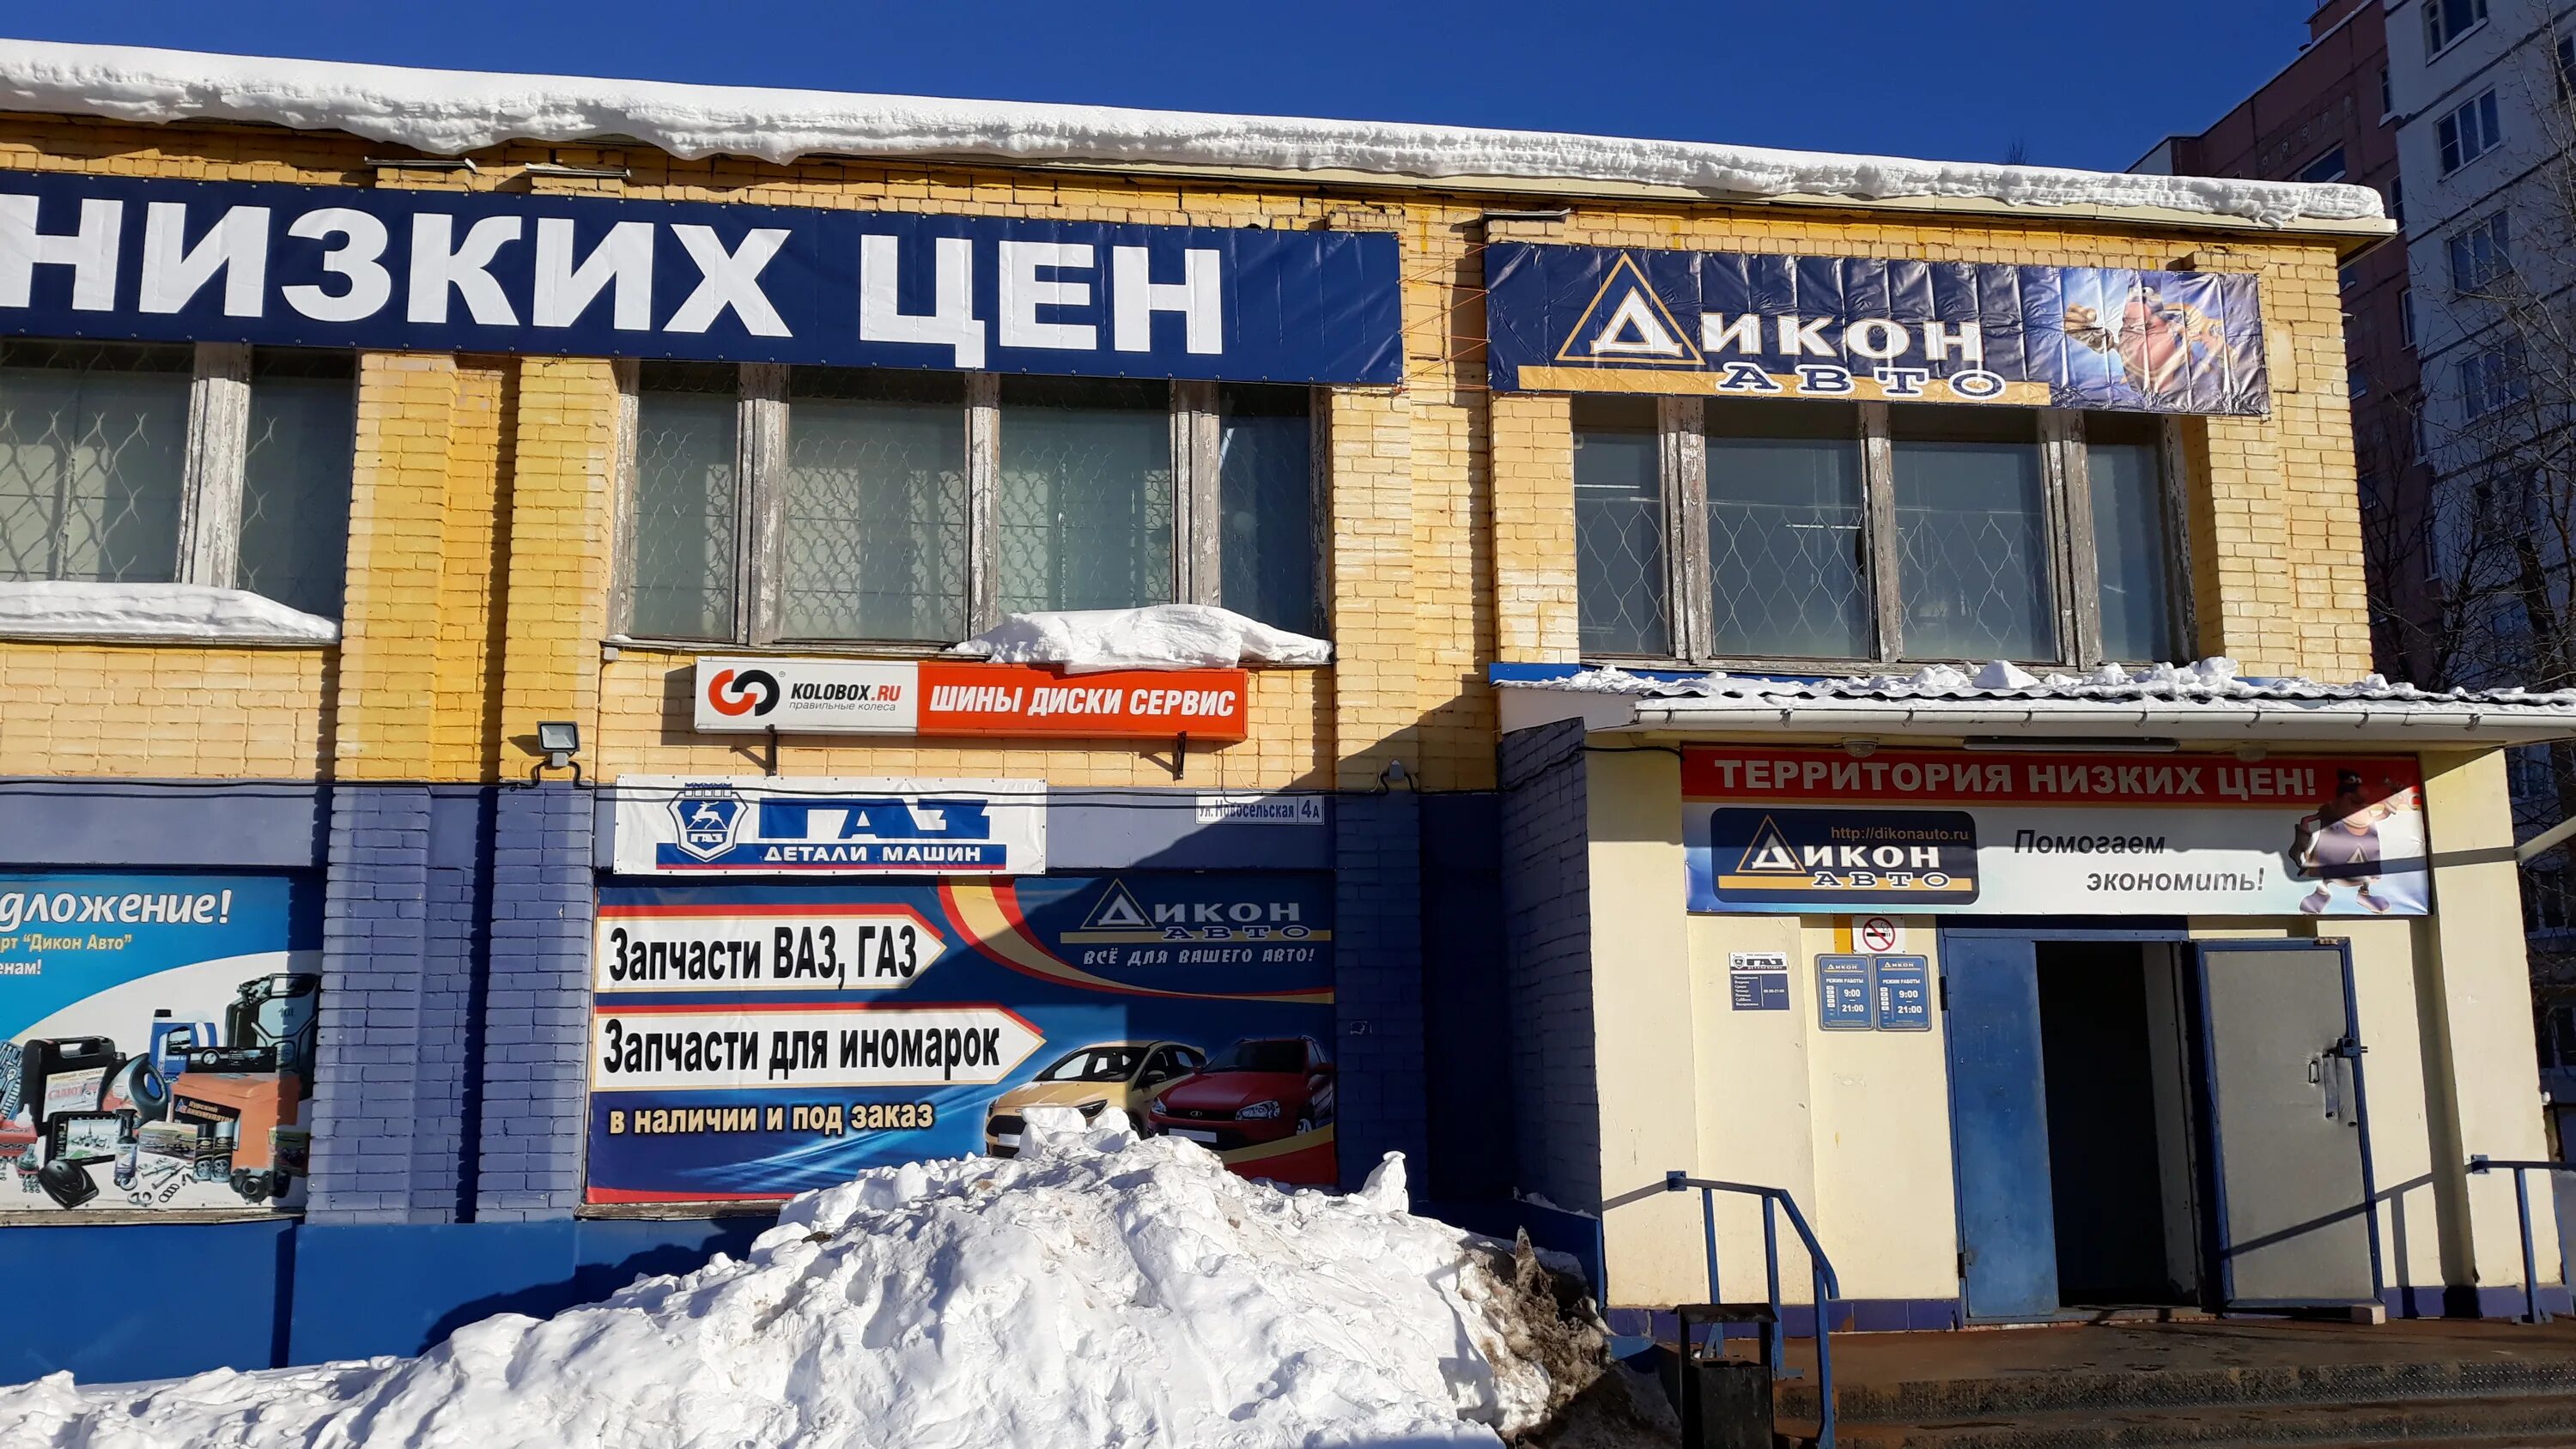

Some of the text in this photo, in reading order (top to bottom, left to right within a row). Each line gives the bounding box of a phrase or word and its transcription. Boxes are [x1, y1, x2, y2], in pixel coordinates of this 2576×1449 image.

[0, 194, 1224, 369] НИЗКИХ ЦЕН
[1717, 361, 2007, 400] АВТО
[790, 682, 902, 701] KOLOBOX.RU
[929, 684, 1236, 718] ШИНЫ ДИСКИ СЕРВИС
[788, 701, 896, 712] правильные колеса
[1714, 759, 2317, 801] ТЕРРИТОРИЯ НИЗКИХ ЦЕН!
[759, 797, 992, 840] ГАЗ
[1216, 799, 1295, 819] Новосельская
[690, 833, 723, 843] ГАЗ
[1831, 827, 1970, 841] http://dikonauto.ru
[2014, 829, 2166, 854] Помогаем
[763, 846, 981, 862] ДЕТАЛИ МАШИН
[1812, 871, 1951, 888] АВТО
[2087, 867, 2265, 893] экономить!
[1162, 925, 1310, 941] АВТО
[609, 925, 918, 990] Запчасти ВАЗ, ГАЗ
[1084, 948, 1315, 967] ВСЁ ДЛЯ ВАШЕГО АВТО!
[1844, 989, 1861, 997] 9:00
[1899, 990, 1918, 998] 9:00
[1897, 1005, 1923, 1014] 21:00
[604, 1018, 1000, 1081] Запчасти для иномарок
[610, 1101, 934, 1135] в наличии и под заказ
